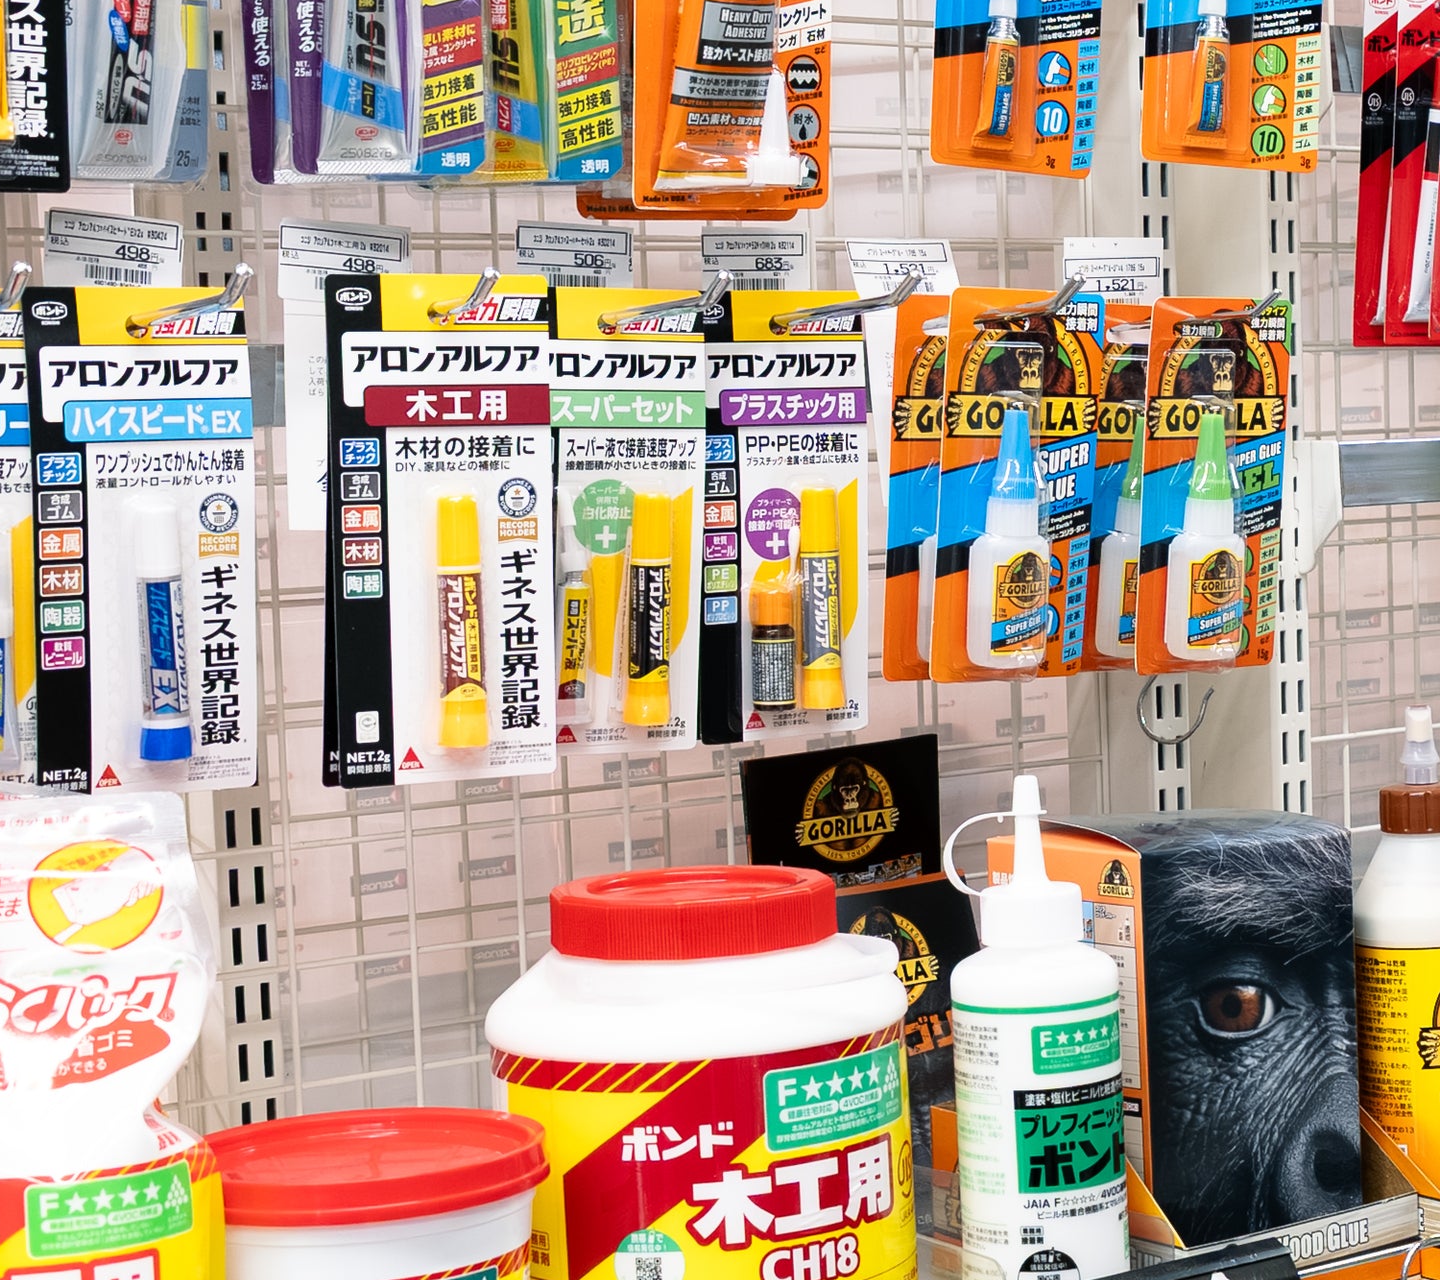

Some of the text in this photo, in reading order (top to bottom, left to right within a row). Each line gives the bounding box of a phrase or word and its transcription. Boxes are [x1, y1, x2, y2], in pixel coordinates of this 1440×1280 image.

[558, 89, 613, 117] 強力接着
[562, 117, 614, 148] 高性能
[115, 244, 152, 263] 498
[755, 256, 783, 271] 683
[406, 389, 507, 422] 木工用
[728, 391, 857, 422] プラスチック用
[71, 407, 204, 437] ハイスピード
[395, 436, 535, 457] 木材の接着に
[96, 449, 245, 475] ワンプッシュでかんたん接着
[96, 474, 236, 489] 液量コントロールがしやすい
[200, 565, 241, 746] ギネス世界記録
[800, 809, 898, 849] GORILLA
[620, 1120, 735, 1165] ボンド
[692, 1139, 891, 1246] 木工用
